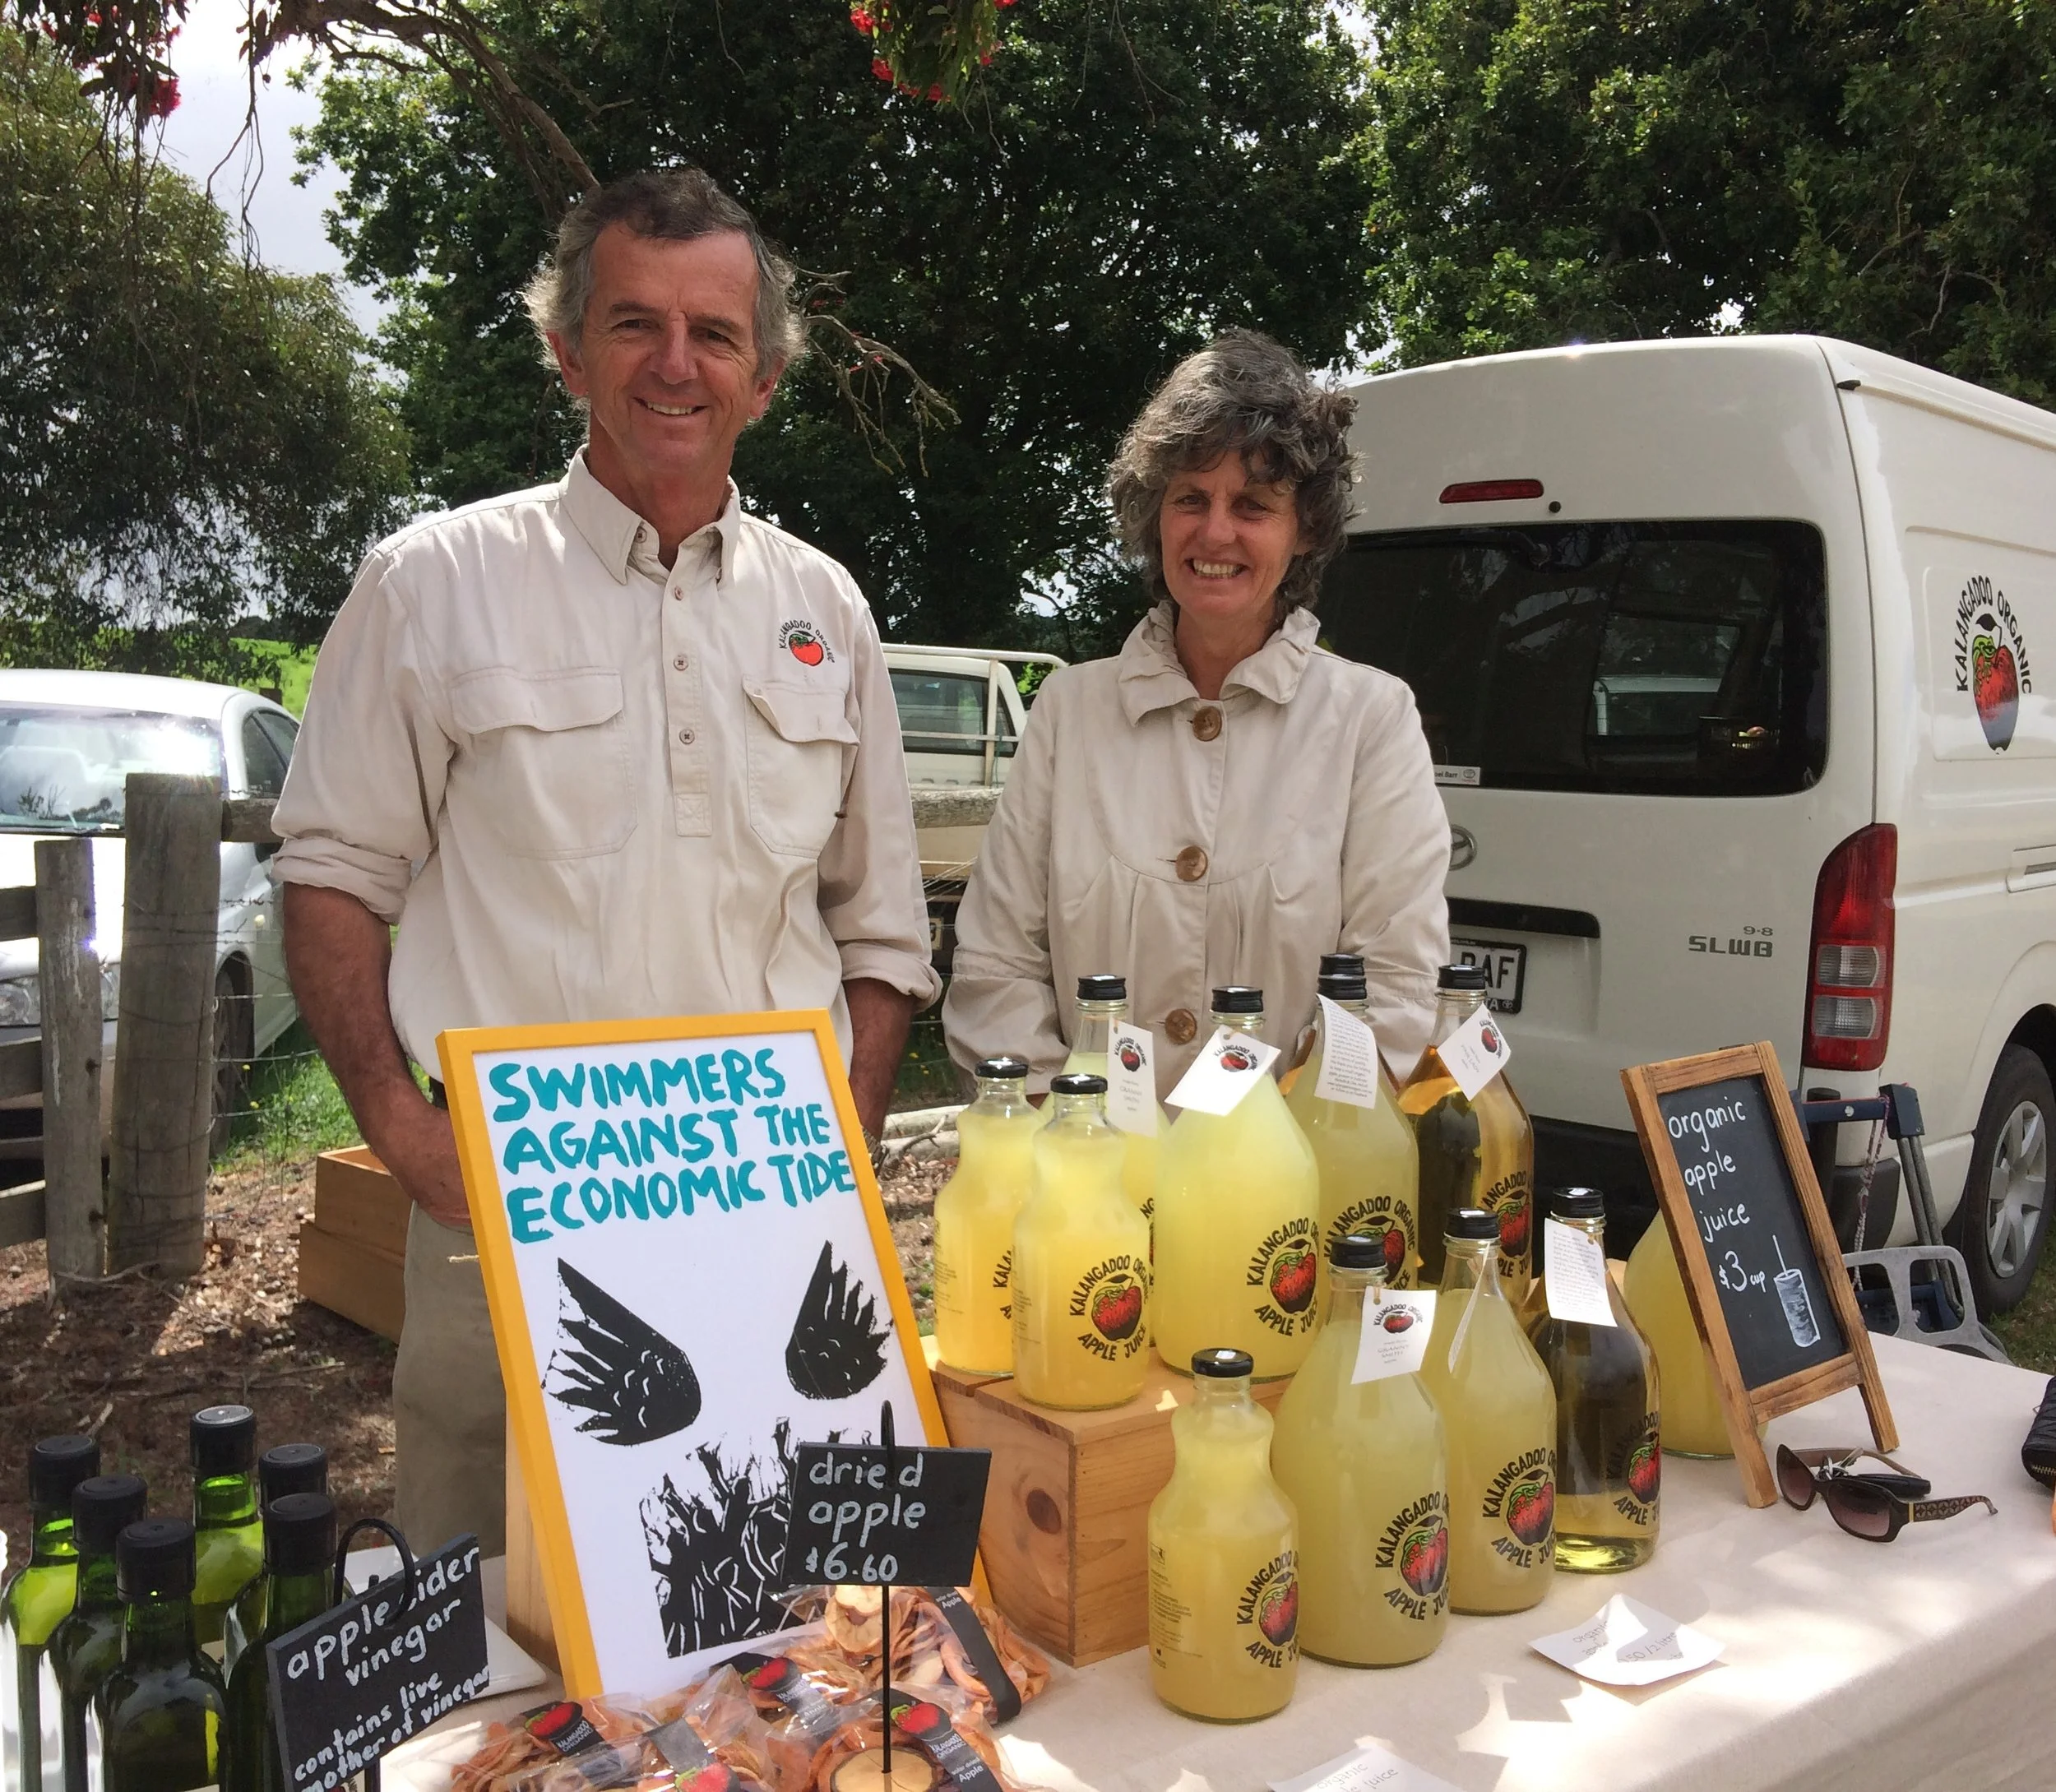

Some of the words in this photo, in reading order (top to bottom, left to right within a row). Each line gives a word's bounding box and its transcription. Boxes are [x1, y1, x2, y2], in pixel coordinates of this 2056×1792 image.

[1955, 576, 1993, 692] KALANGADOO
[1998, 590, 2032, 694] ORGANIC
[1688, 936, 1773, 958] SLWB
[489, 1048, 786, 1123] SWIMMERS
[502, 1109, 738, 1175] AGAINST
[754, 1104, 830, 1146] THE
[1669, 1096, 1747, 1153] organic
[507, 1160, 766, 1244] ECONOMIC
[767, 1151, 857, 1209] TIDE
[1684, 1150, 1737, 1196] apple
[1246, 1217, 1309, 1285] KALANGADOO
[1324, 1196, 1392, 1257] KLANGADOO
[1393, 1200, 1415, 1251] ORGANIC
[1699, 1203, 1750, 1243] juice
[1069, 1254, 1131, 1316] KALANGADOO
[1719, 1250, 1748, 1292] $3
[1750, 1271, 1767, 1293] cup
[1077, 1332, 1117, 1362] APPLE
[1123, 1323, 1146, 1359] JUICE
[1253, 1304, 1294, 1336] APPLE
[809, 1452, 924, 1490] dried
[1483, 1447, 1546, 1517] KALANGADOO
[808, 1493, 927, 1548] apple
[1375, 1491, 1441, 1567] KALANGADOO
[1613, 1496, 1649, 1526] APPLE
[805, 1541, 899, 1582] $6.60
[1491, 1536, 1532, 1569] APPLE
[1236, 1550, 1292, 1625] KALANGADOO
[1383, 1587, 1427, 1620] APPLE
[288, 1601, 391, 1680] apple
[345, 1599, 461, 1687] vinegar
[1245, 1641, 1283, 1669] APPLE
[295, 1705, 392, 1781] contains
[400, 1673, 443, 1709] live
[301, 1737, 386, 1792] mother
[391, 1707, 414, 1742] of
[958, 1764, 984, 1783] Apple
[1364, 1767, 1399, 1790] juice
